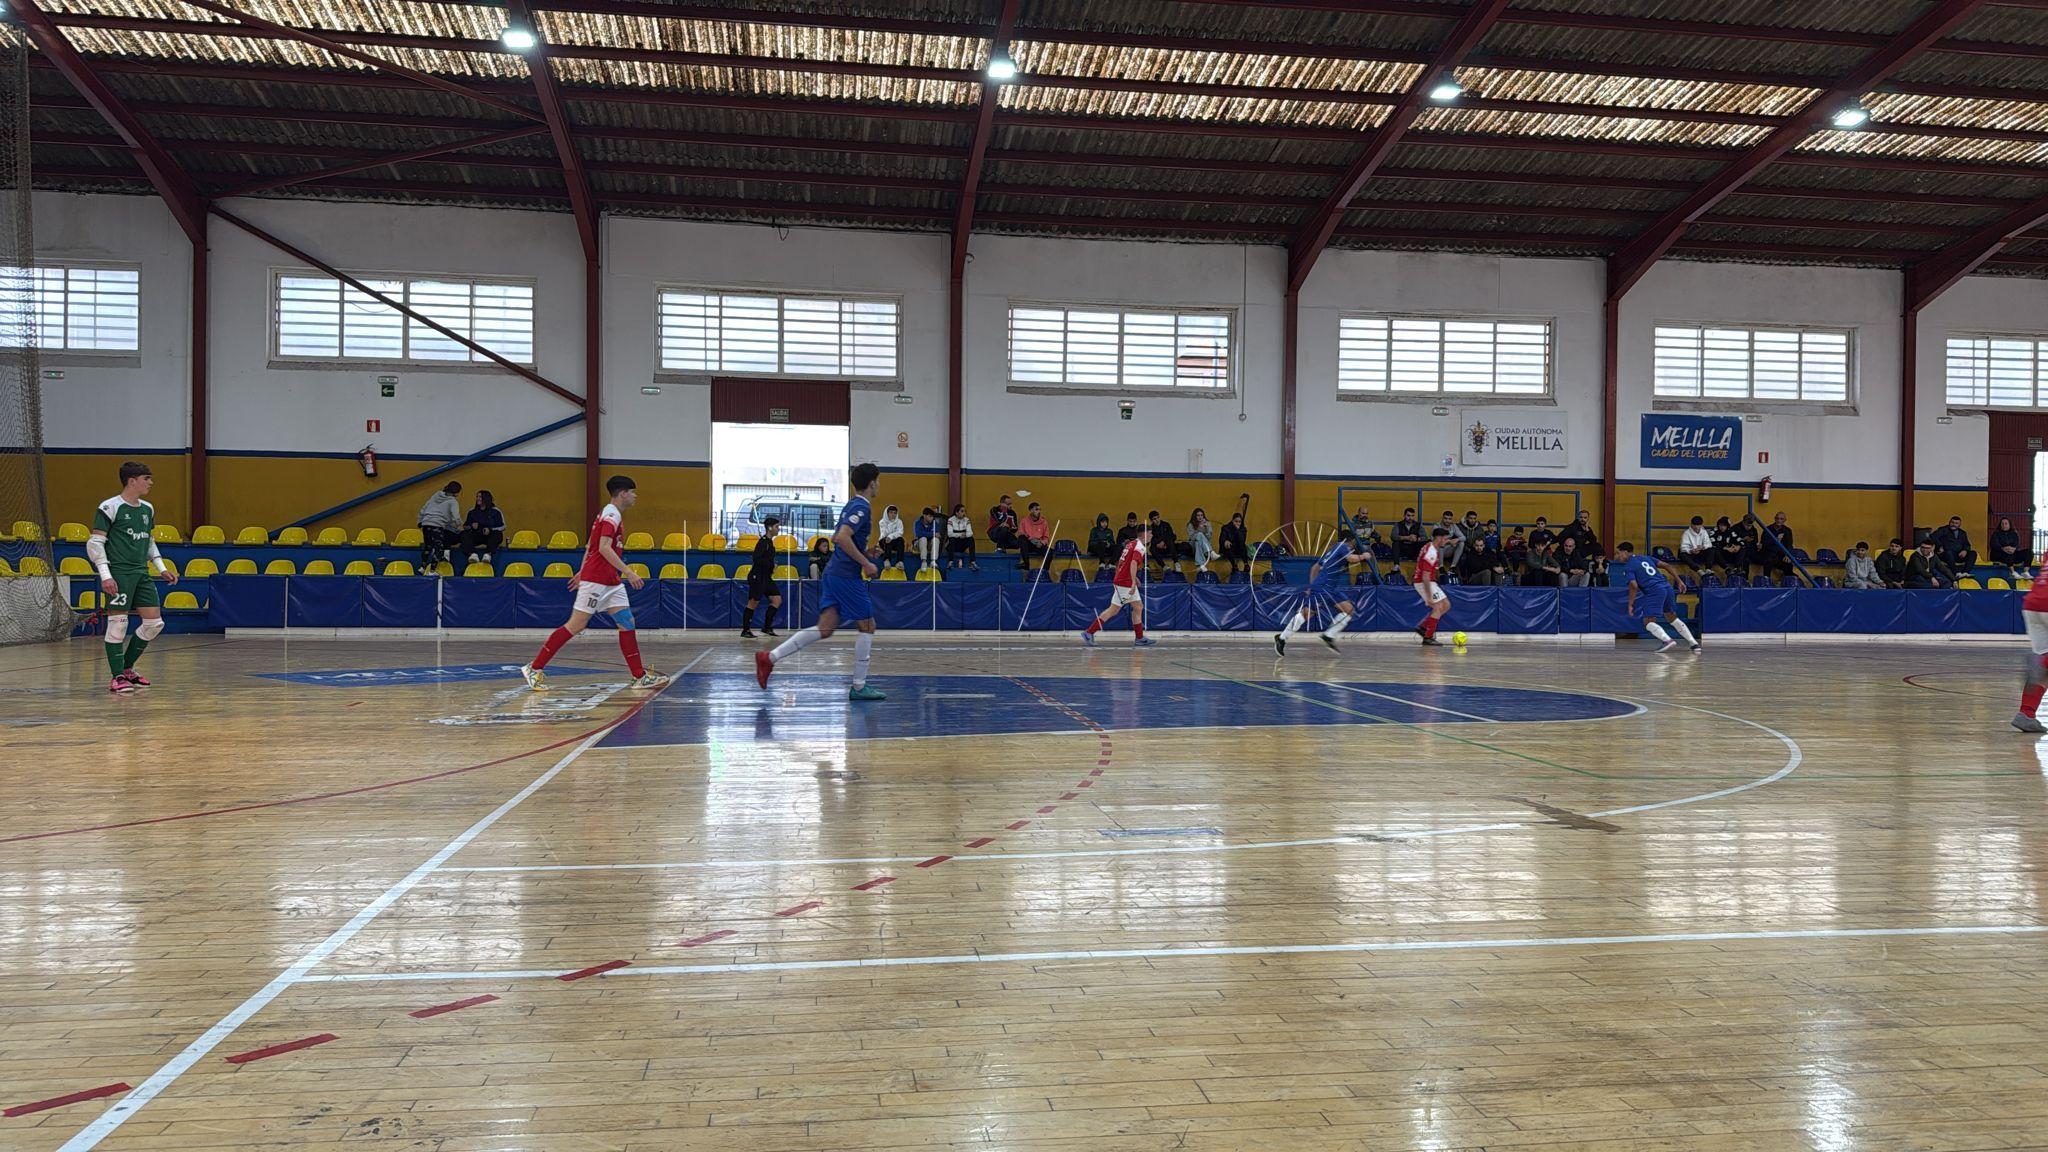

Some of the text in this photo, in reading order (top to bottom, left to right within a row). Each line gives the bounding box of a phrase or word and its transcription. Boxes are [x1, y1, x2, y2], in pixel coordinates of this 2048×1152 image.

[1494, 427, 1563, 435] CIUDAD AUTÓNOMA
[1651, 425, 1733, 449] MELILLA
[1496, 436, 1564, 451] MELILLA
[1651, 448, 1729, 459] CIUDAD DEL DEPORTE
[1641, 561, 1657, 576] 8
[109, 592, 128, 606] 23
[586, 596, 598, 609] 10
